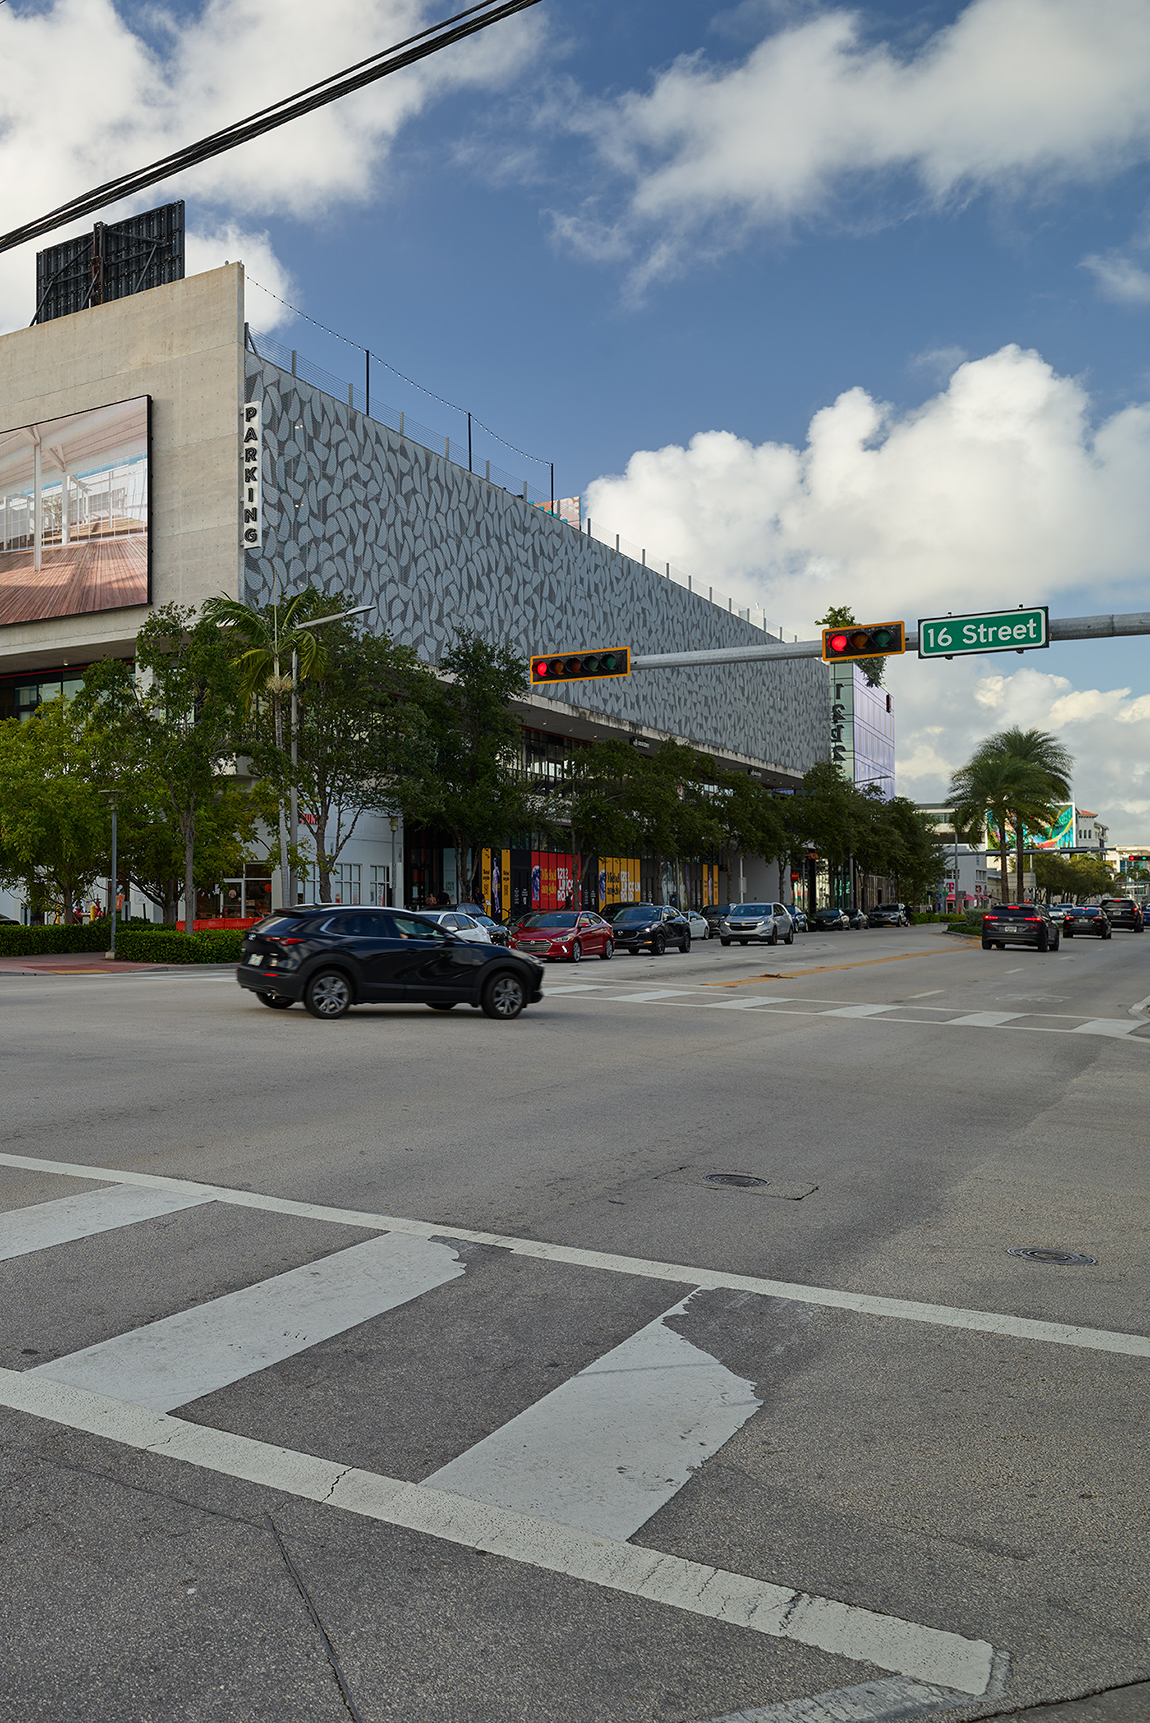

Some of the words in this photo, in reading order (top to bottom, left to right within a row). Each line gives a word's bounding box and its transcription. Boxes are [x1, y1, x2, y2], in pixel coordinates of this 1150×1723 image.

[244, 406, 258, 543] PARKING
[927, 627, 953, 648] 16
[962, 618, 1037, 644] Street
[620, 891, 634, 902] ROAD
[621, 881, 641, 892] LINCOLN
